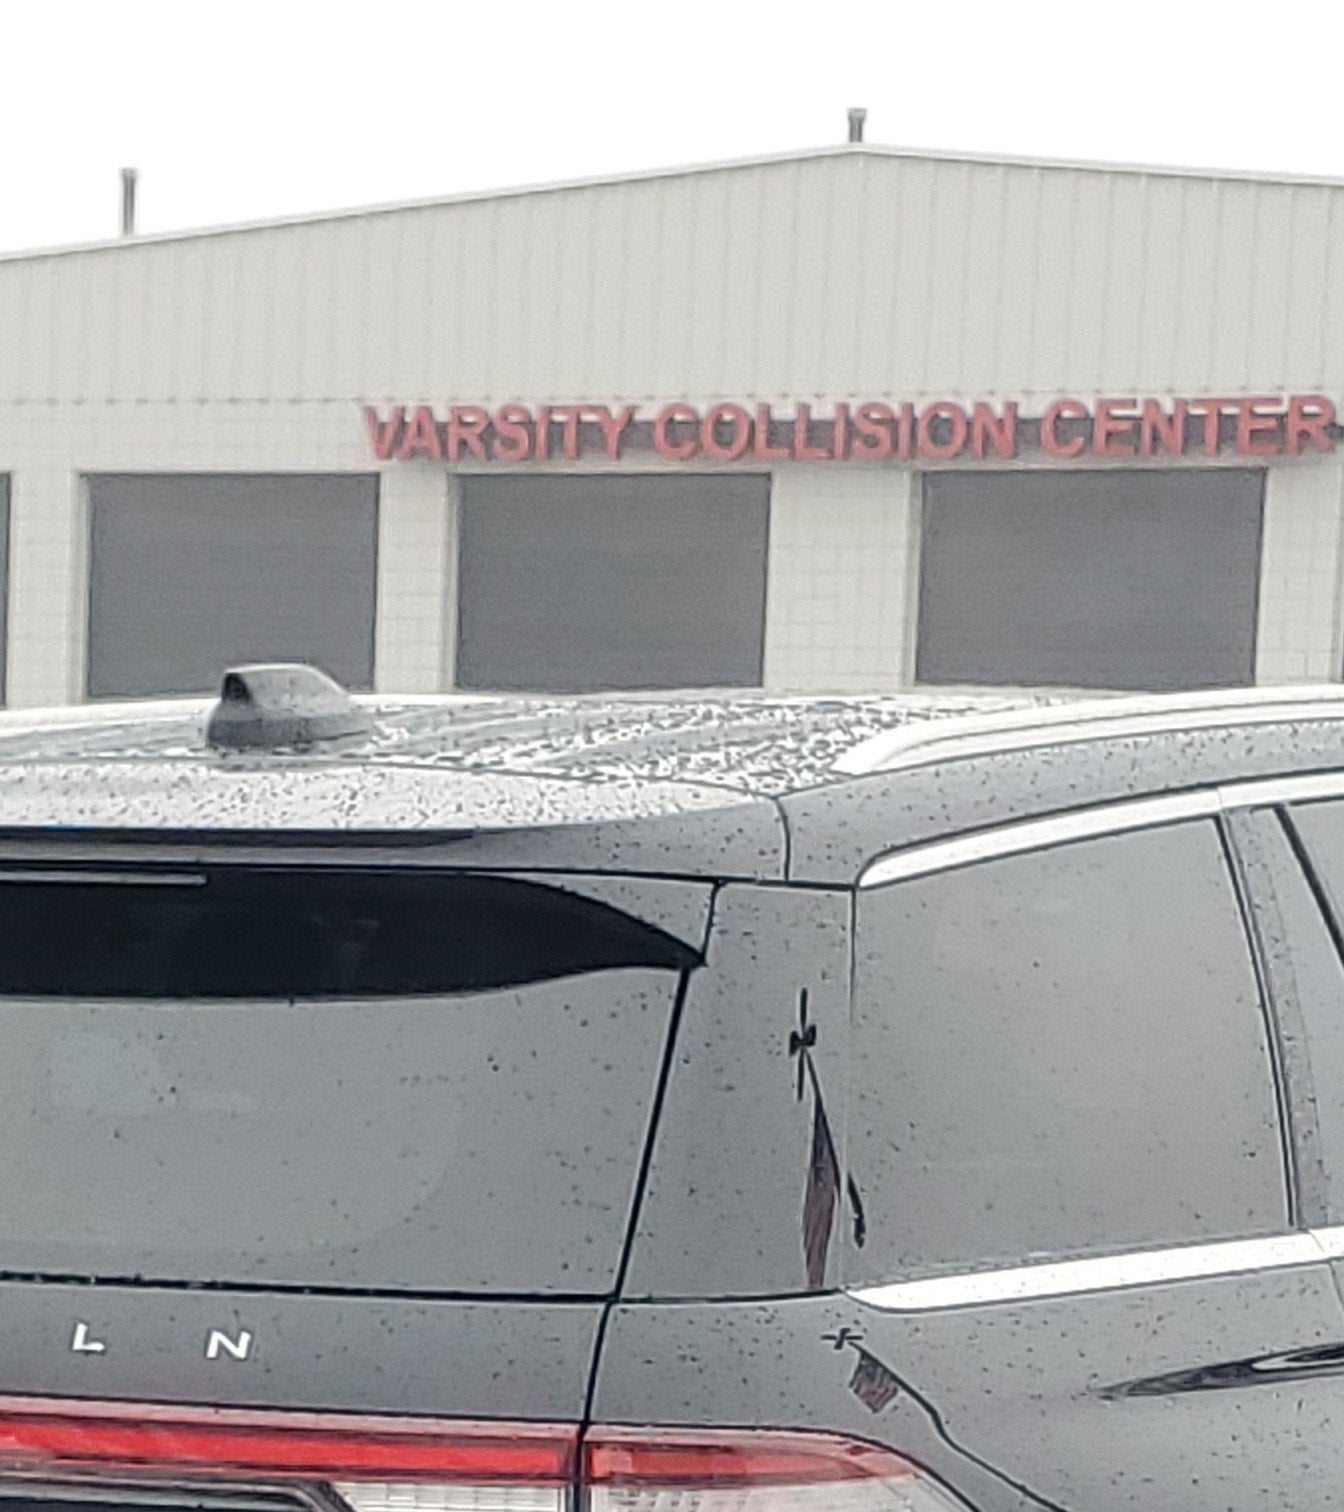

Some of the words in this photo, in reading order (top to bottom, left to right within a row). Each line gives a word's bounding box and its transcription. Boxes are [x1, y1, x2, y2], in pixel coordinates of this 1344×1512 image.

[364, 404, 639, 462] VARSITY
[652, 402, 1019, 461] COLLISION
[1040, 395, 1339, 457] CENTER
